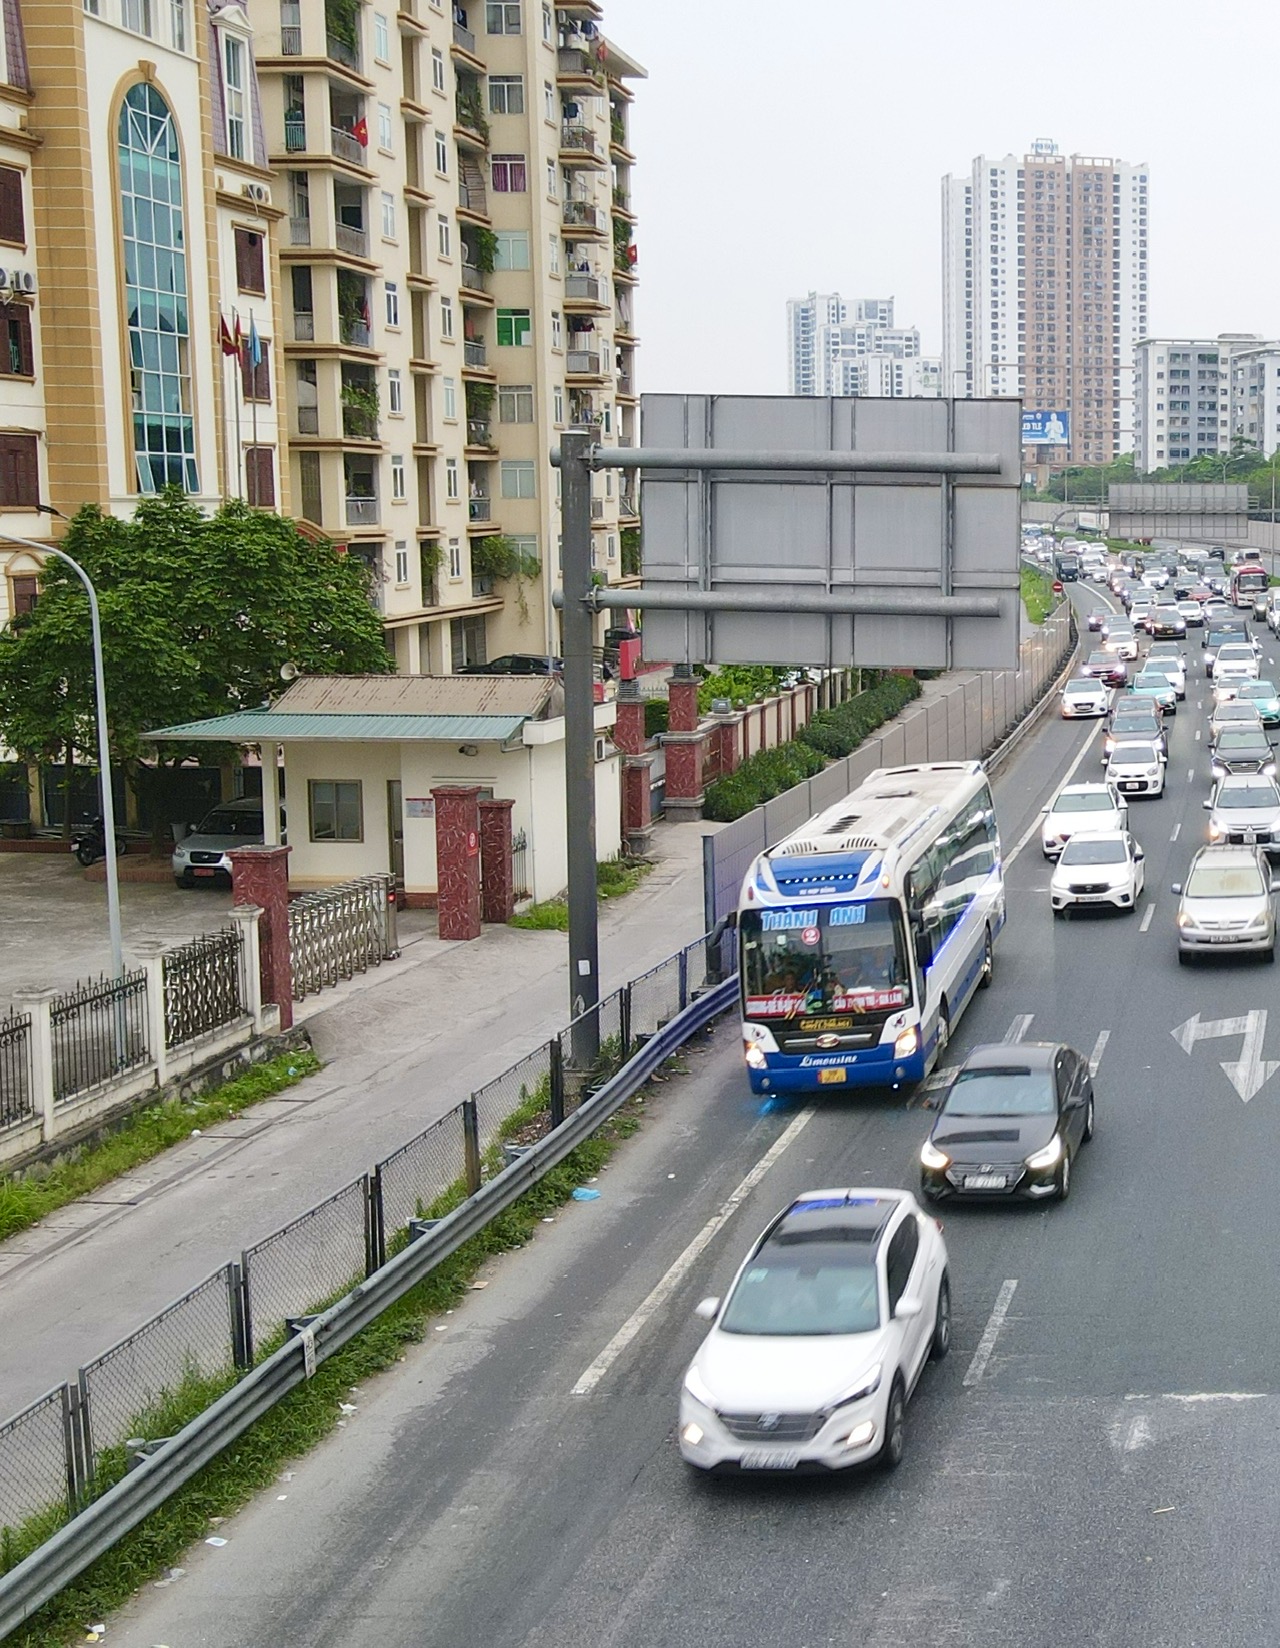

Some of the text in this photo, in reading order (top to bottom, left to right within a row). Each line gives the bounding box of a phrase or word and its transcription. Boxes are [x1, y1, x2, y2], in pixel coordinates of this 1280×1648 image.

[761, 907, 818, 931] THÀNH
[805, 929, 817, 942] 2
[799, 1055, 858, 1068] Limousine
